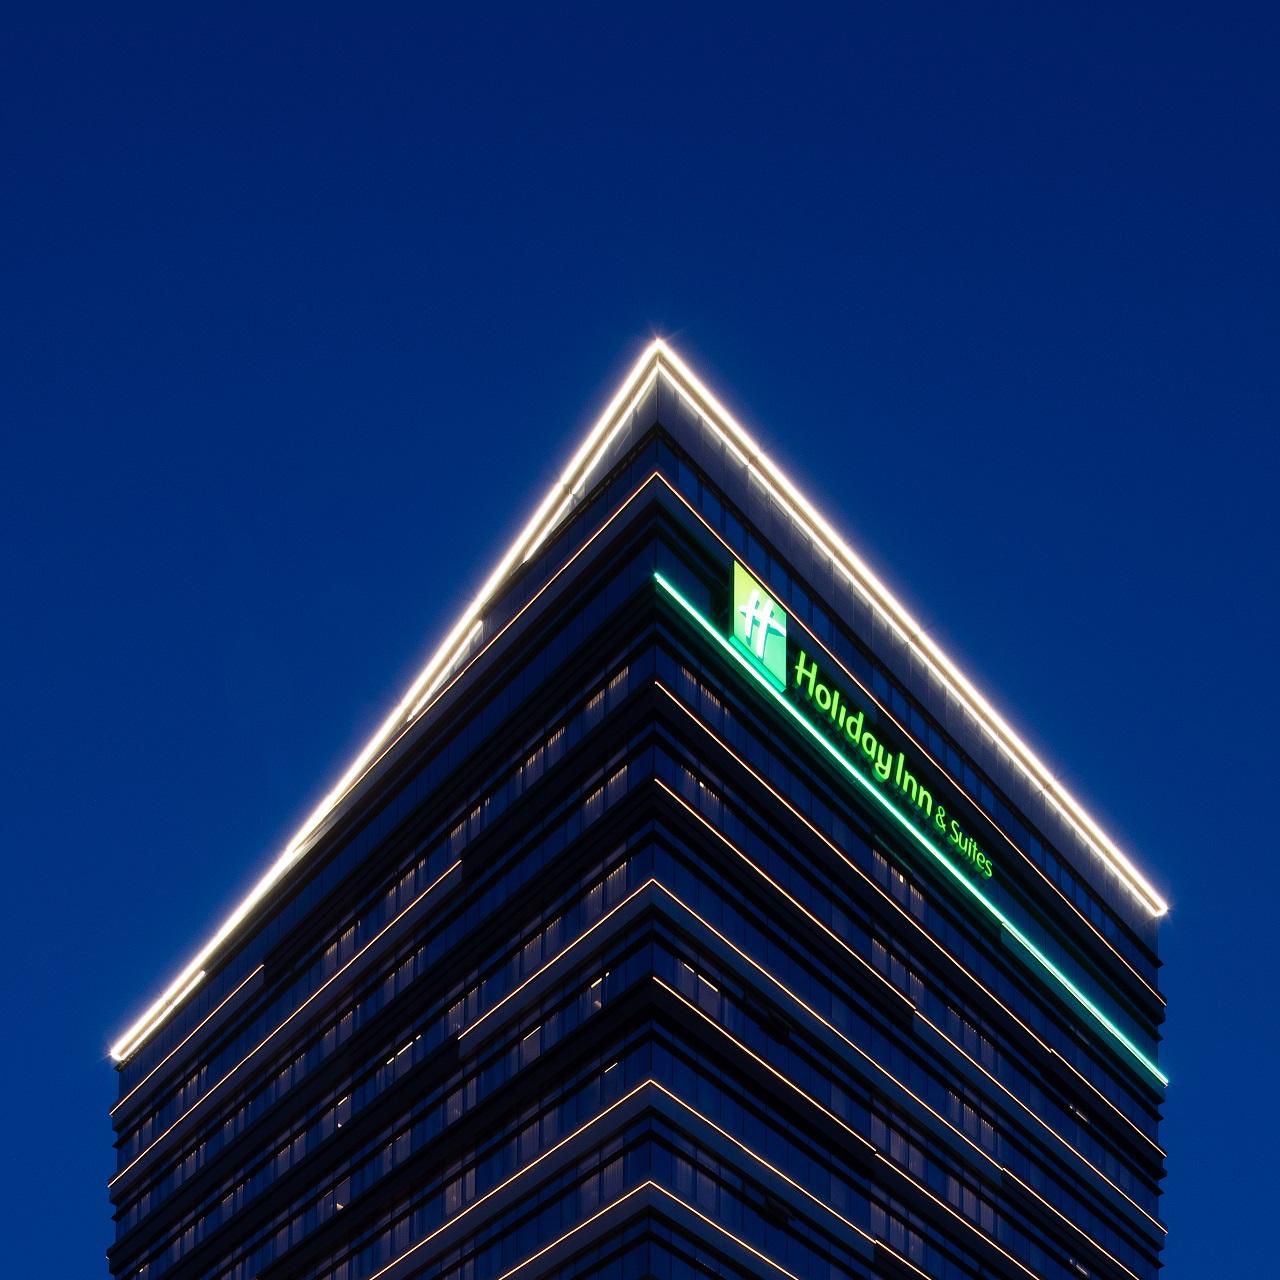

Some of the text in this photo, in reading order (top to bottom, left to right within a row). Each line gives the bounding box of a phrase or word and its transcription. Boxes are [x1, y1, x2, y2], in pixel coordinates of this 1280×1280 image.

[794, 649, 994, 878] Holiday Inn & Suites
